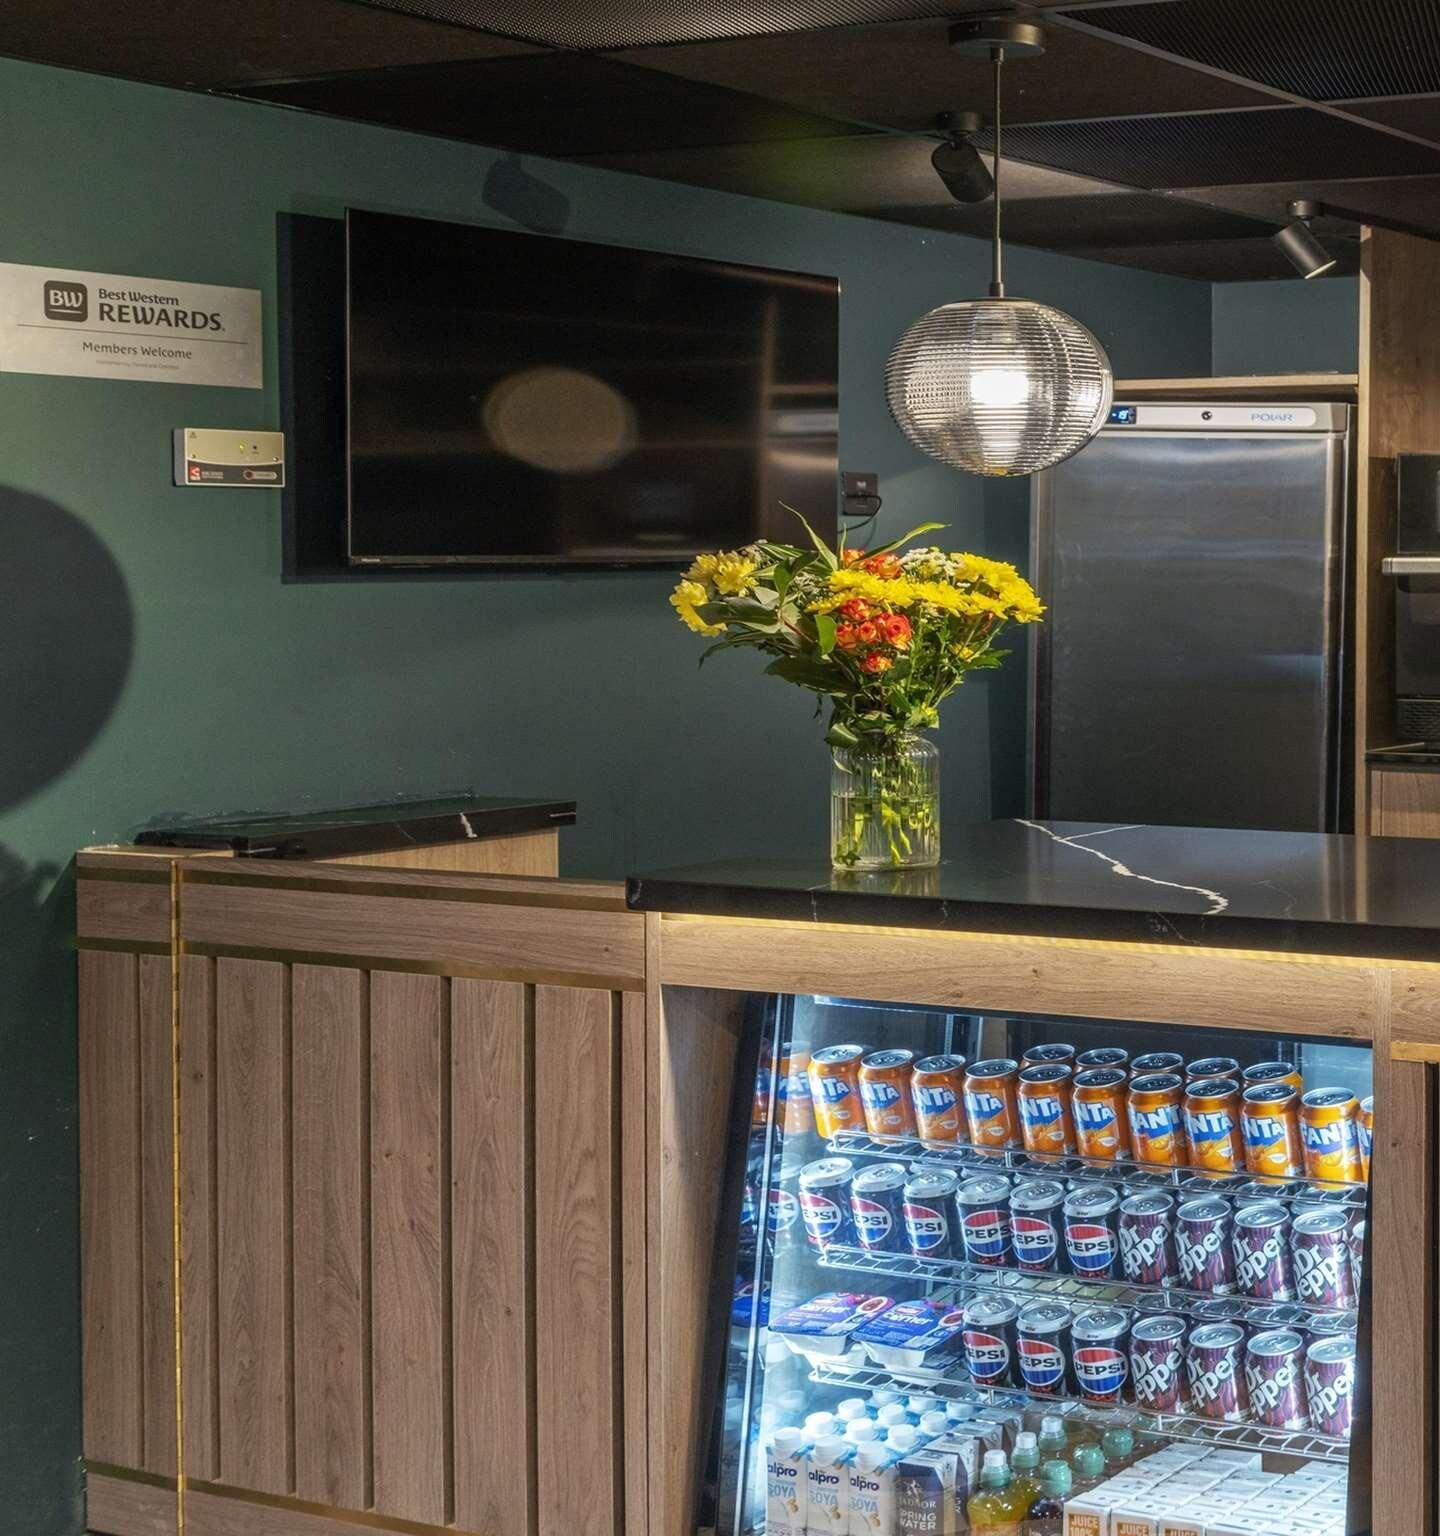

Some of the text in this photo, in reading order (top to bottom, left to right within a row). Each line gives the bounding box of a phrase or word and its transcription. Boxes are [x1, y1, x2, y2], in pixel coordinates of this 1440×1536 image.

[49, 290, 84, 308] BW
[98, 287, 180, 306] Best Western
[82, 341, 192, 359] Members Welcome
[1251, 413, 1294, 422] POLAR
[912, 1086, 957, 1112] NTA
[1017, 1097, 1065, 1118] NTA
[1073, 1102, 1114, 1124] NTA
[1185, 1112, 1231, 1135] NTA
[1241, 1117, 1286, 1138] NTA
[964, 1226, 1011, 1239] PEPS
[1012, 1233, 1055, 1246] EPSI
[1294, 1244, 1323, 1278] Dr
[966, 1347, 1006, 1360] EPSI
[1019, 1355, 1061, 1368] EPSI
[1075, 1361, 1126, 1376] PEPSI
[1130, 1350, 1155, 1381] Dr
[767, 1462, 798, 1477] alpro
[808, 1470, 840, 1485] alpro
[850, 1475, 880, 1491] alpro
[900, 1510, 937, 1522] PRING
[1071, 1514, 1100, 1529] JUICE
[1119, 1522, 1149, 1535] JUICE
